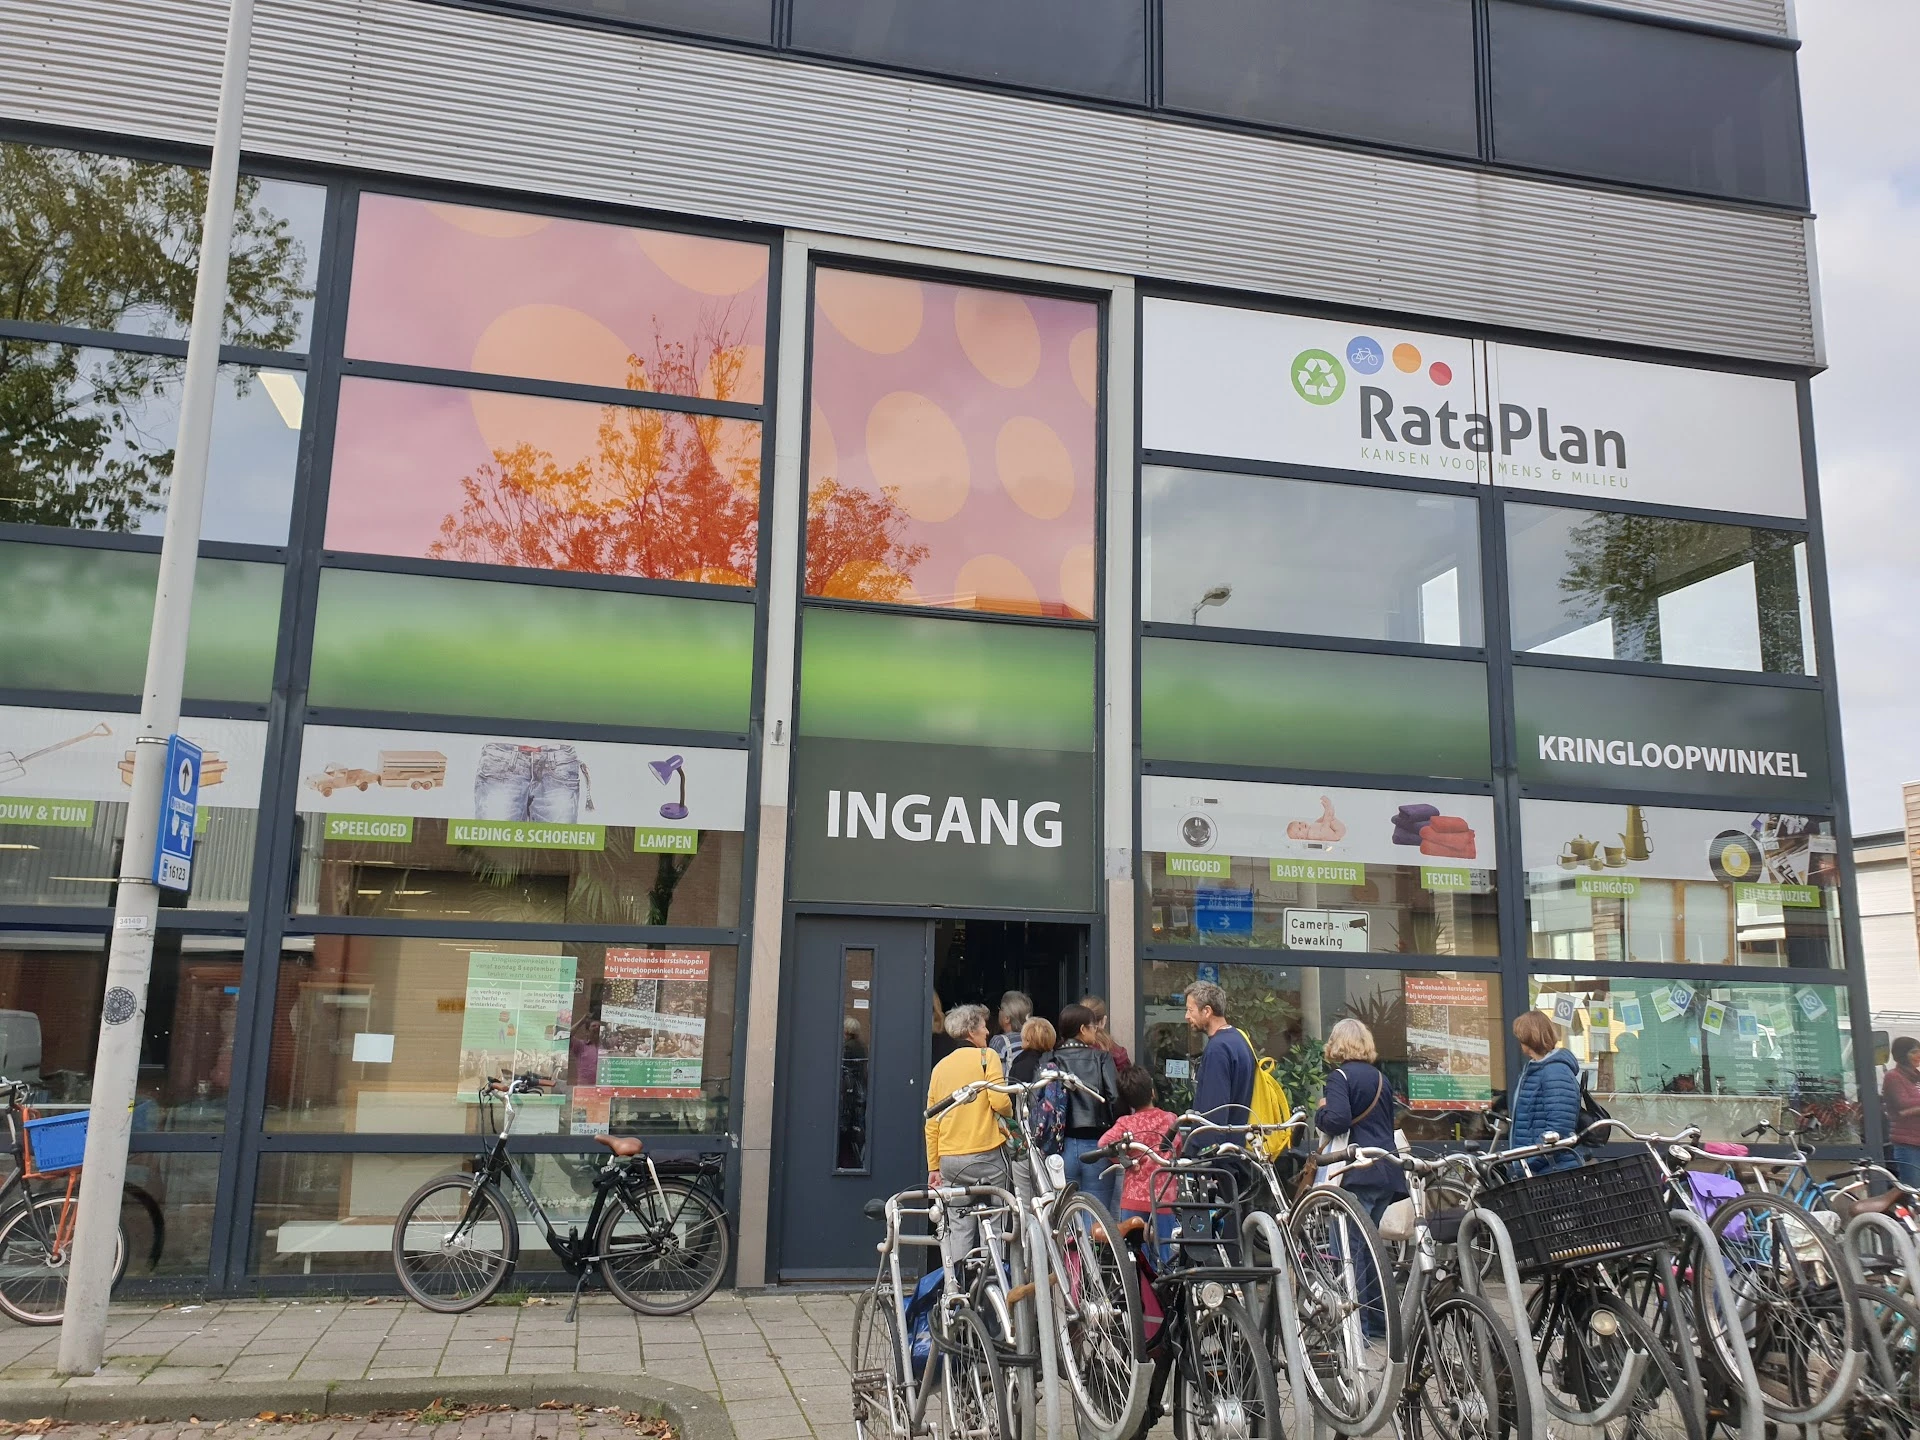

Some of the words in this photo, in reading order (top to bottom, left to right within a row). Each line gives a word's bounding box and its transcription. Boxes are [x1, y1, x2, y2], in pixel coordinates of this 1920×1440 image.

[1360, 386, 1627, 469] RataPlan
[1361, 447, 1430, 465] KANSEN
[1440, 456, 1487, 471] VOOR
[1498, 462, 1542, 479] MENS
[1551, 470, 1562, 481] &
[1572, 471, 1628, 489] MILIEU
[1538, 734, 1807, 778] KRINGLOOPWINKEL
[36, 805, 48, 820] &
[52, 806, 87, 821] TUIN
[827, 790, 1062, 848] INGANG
[331, 820, 406, 839] SPEELGOED
[454, 826, 512, 843] KLEDING
[514, 828, 524, 843] &
[527, 828, 595, 846] SCHOENEN
[640, 833, 692, 850] LAMPEN
[169, 865, 186, 881] 16123
[1171, 858, 1221, 873] WITGOED
[1276, 864, 1305, 879] BABY
[1306, 866, 1316, 879] &
[1317, 866, 1357, 881] PEUTER
[1426, 872, 1465, 887] TEXTIEL
[1581, 880, 1635, 895] KLEINGOED
[1743, 888, 1765, 900] FILM
[1776, 890, 1812, 902] MUZIEK
[1291, 919, 1340, 930] Camera-
[1291, 935, 1343, 949] bewaking
[620, 967, 673, 975] kringloopwinkel
